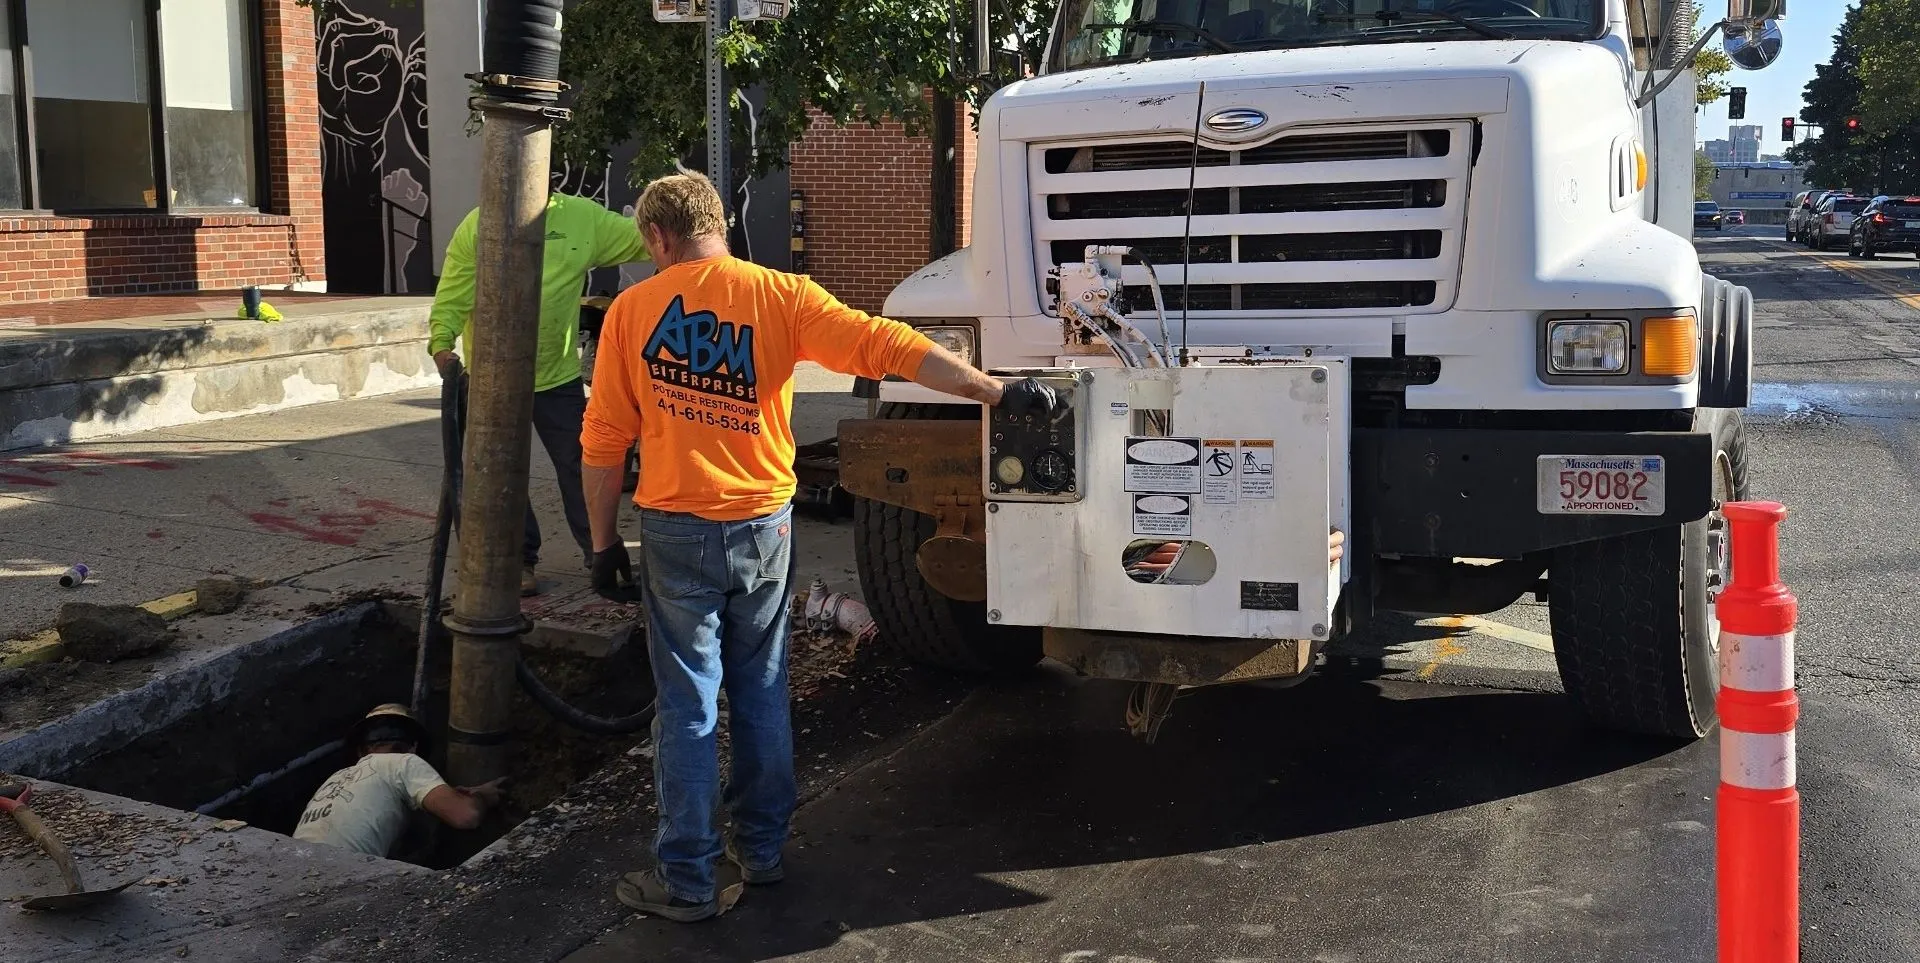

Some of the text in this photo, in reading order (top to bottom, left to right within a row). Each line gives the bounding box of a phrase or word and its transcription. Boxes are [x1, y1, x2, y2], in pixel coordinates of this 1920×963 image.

[641, 294, 757, 386] ABM
[658, 398, 761, 436] 41-615-5348
[698, 396, 760, 418] RESTROOMS
[1565, 458, 1634, 470] Massachusetts
[1560, 471, 1648, 500] 59082
